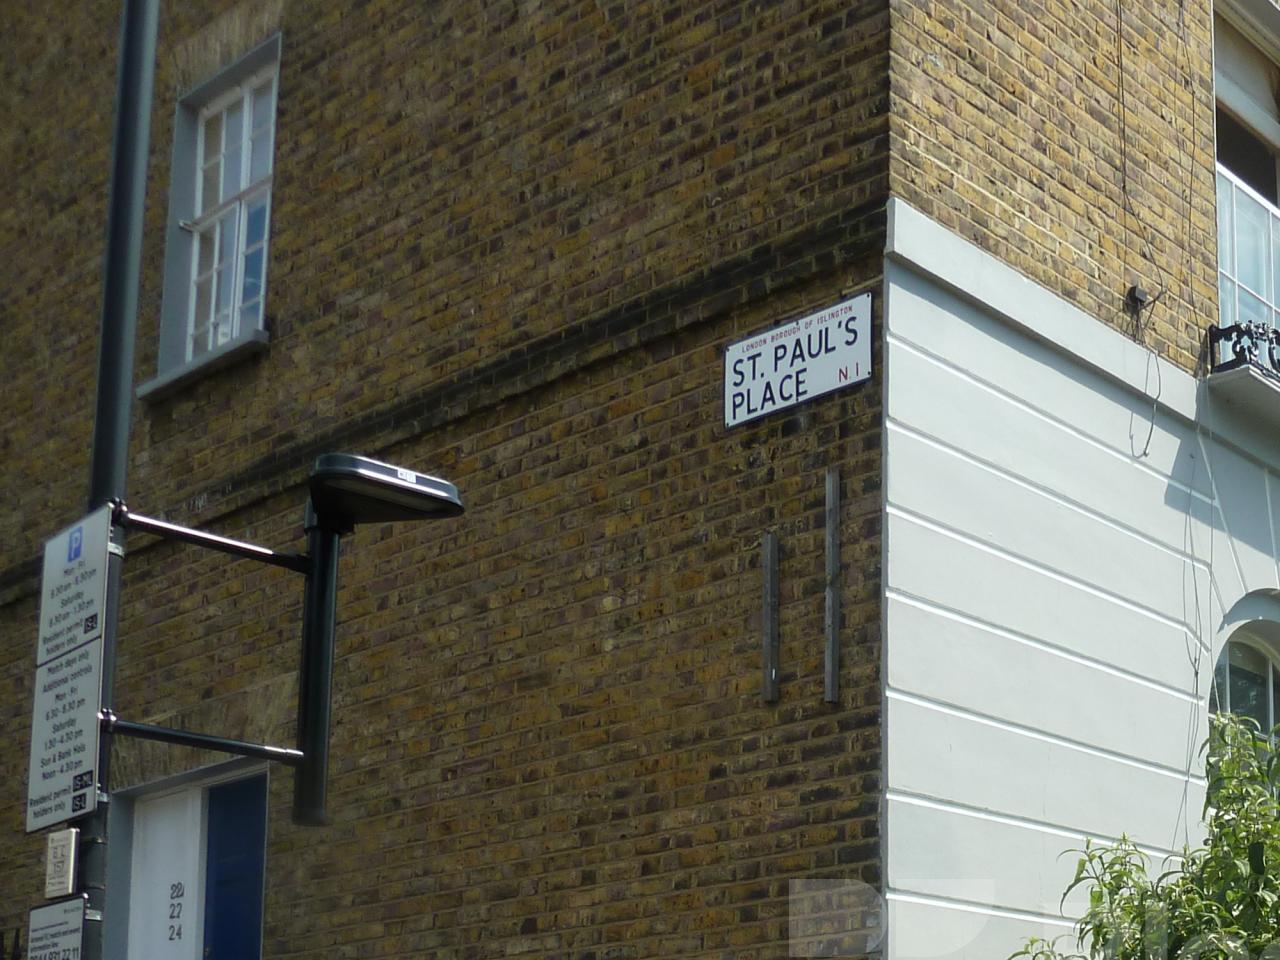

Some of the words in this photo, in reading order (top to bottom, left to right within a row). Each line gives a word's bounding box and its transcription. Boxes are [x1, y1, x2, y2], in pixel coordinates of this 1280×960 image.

[732, 352, 765, 389] ST.
[773, 316, 858, 373] PAUL'S
[741, 338, 767, 353] LONDON
[770, 326, 800, 343] BOROUGH
[804, 319, 813, 330] OF
[817, 304, 853, 325] ISLINGTON
[732, 368, 808, 420] PLACE
[169, 924, 182, 941] 24
